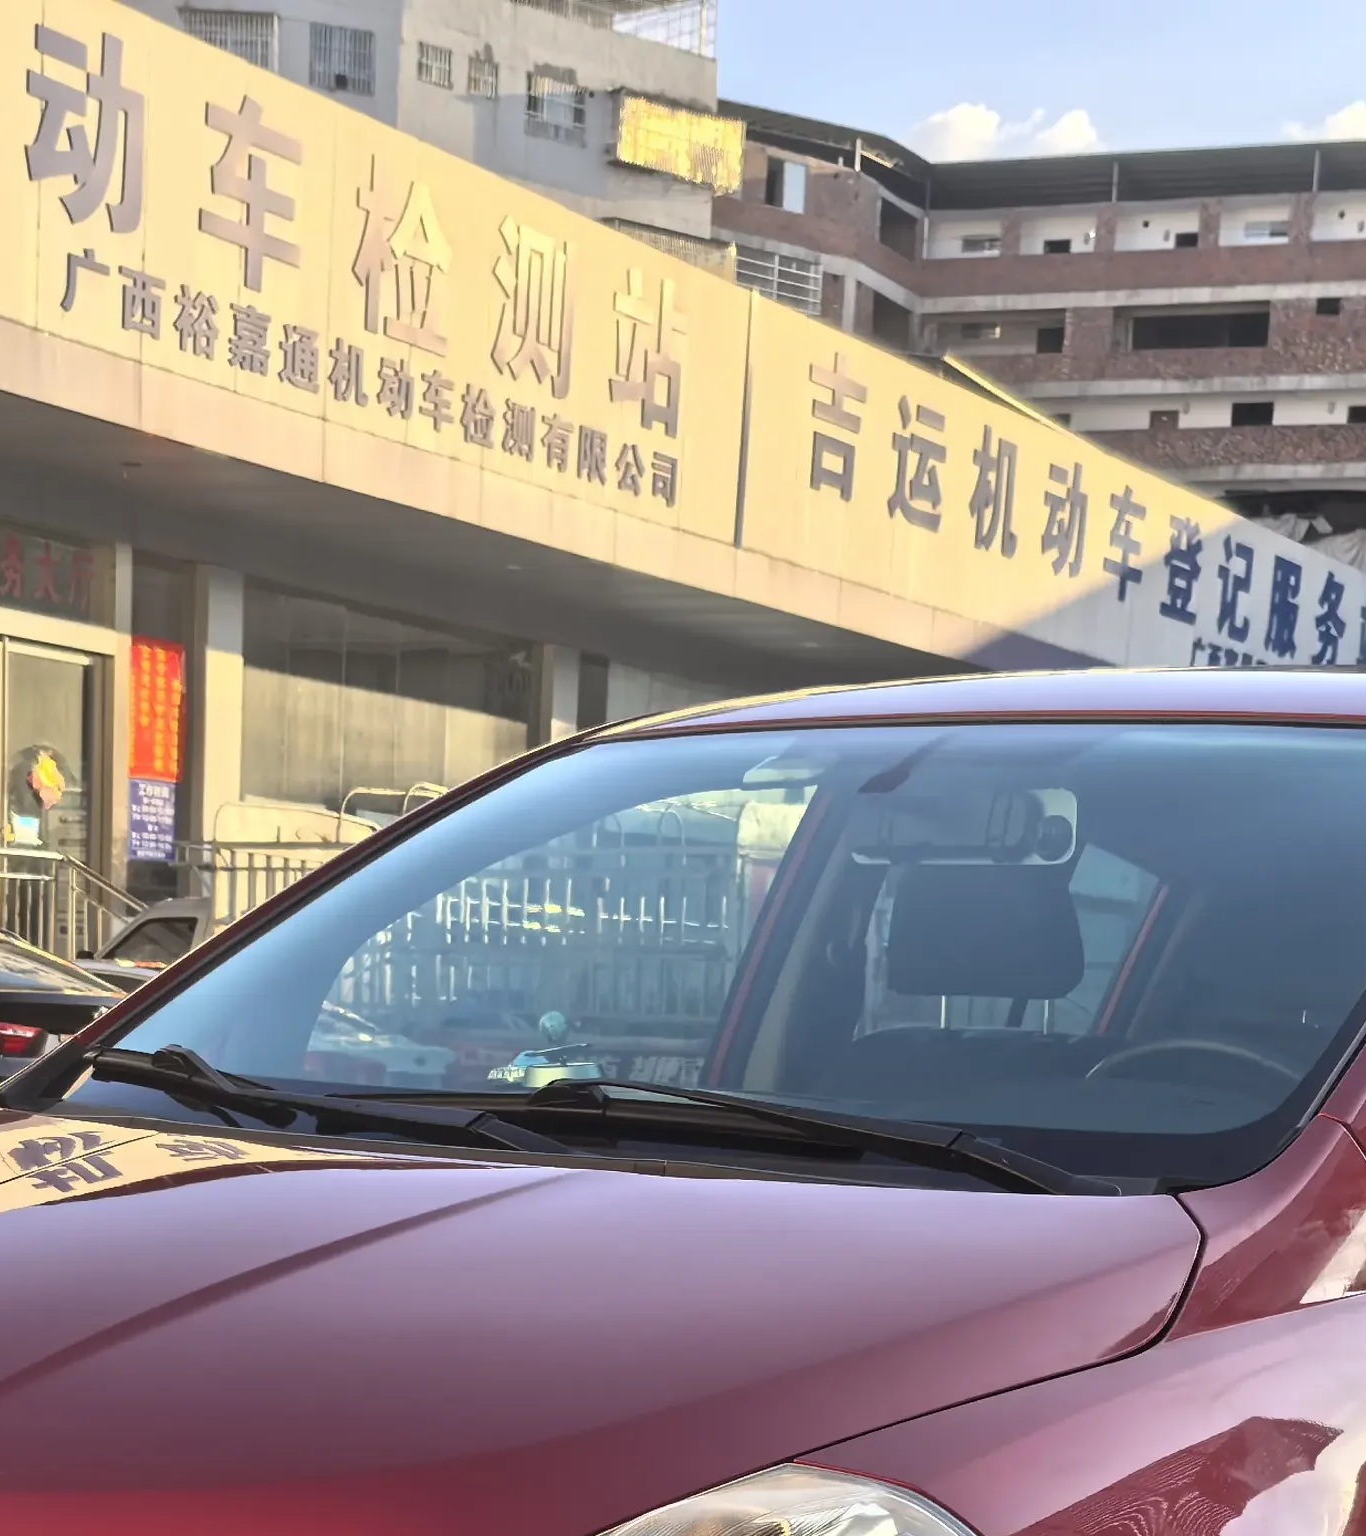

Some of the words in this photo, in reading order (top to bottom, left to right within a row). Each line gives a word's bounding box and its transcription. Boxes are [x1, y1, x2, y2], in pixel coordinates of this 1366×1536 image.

[59, 248, 678, 509] 广西裕嘉通机动车检测有限公司
